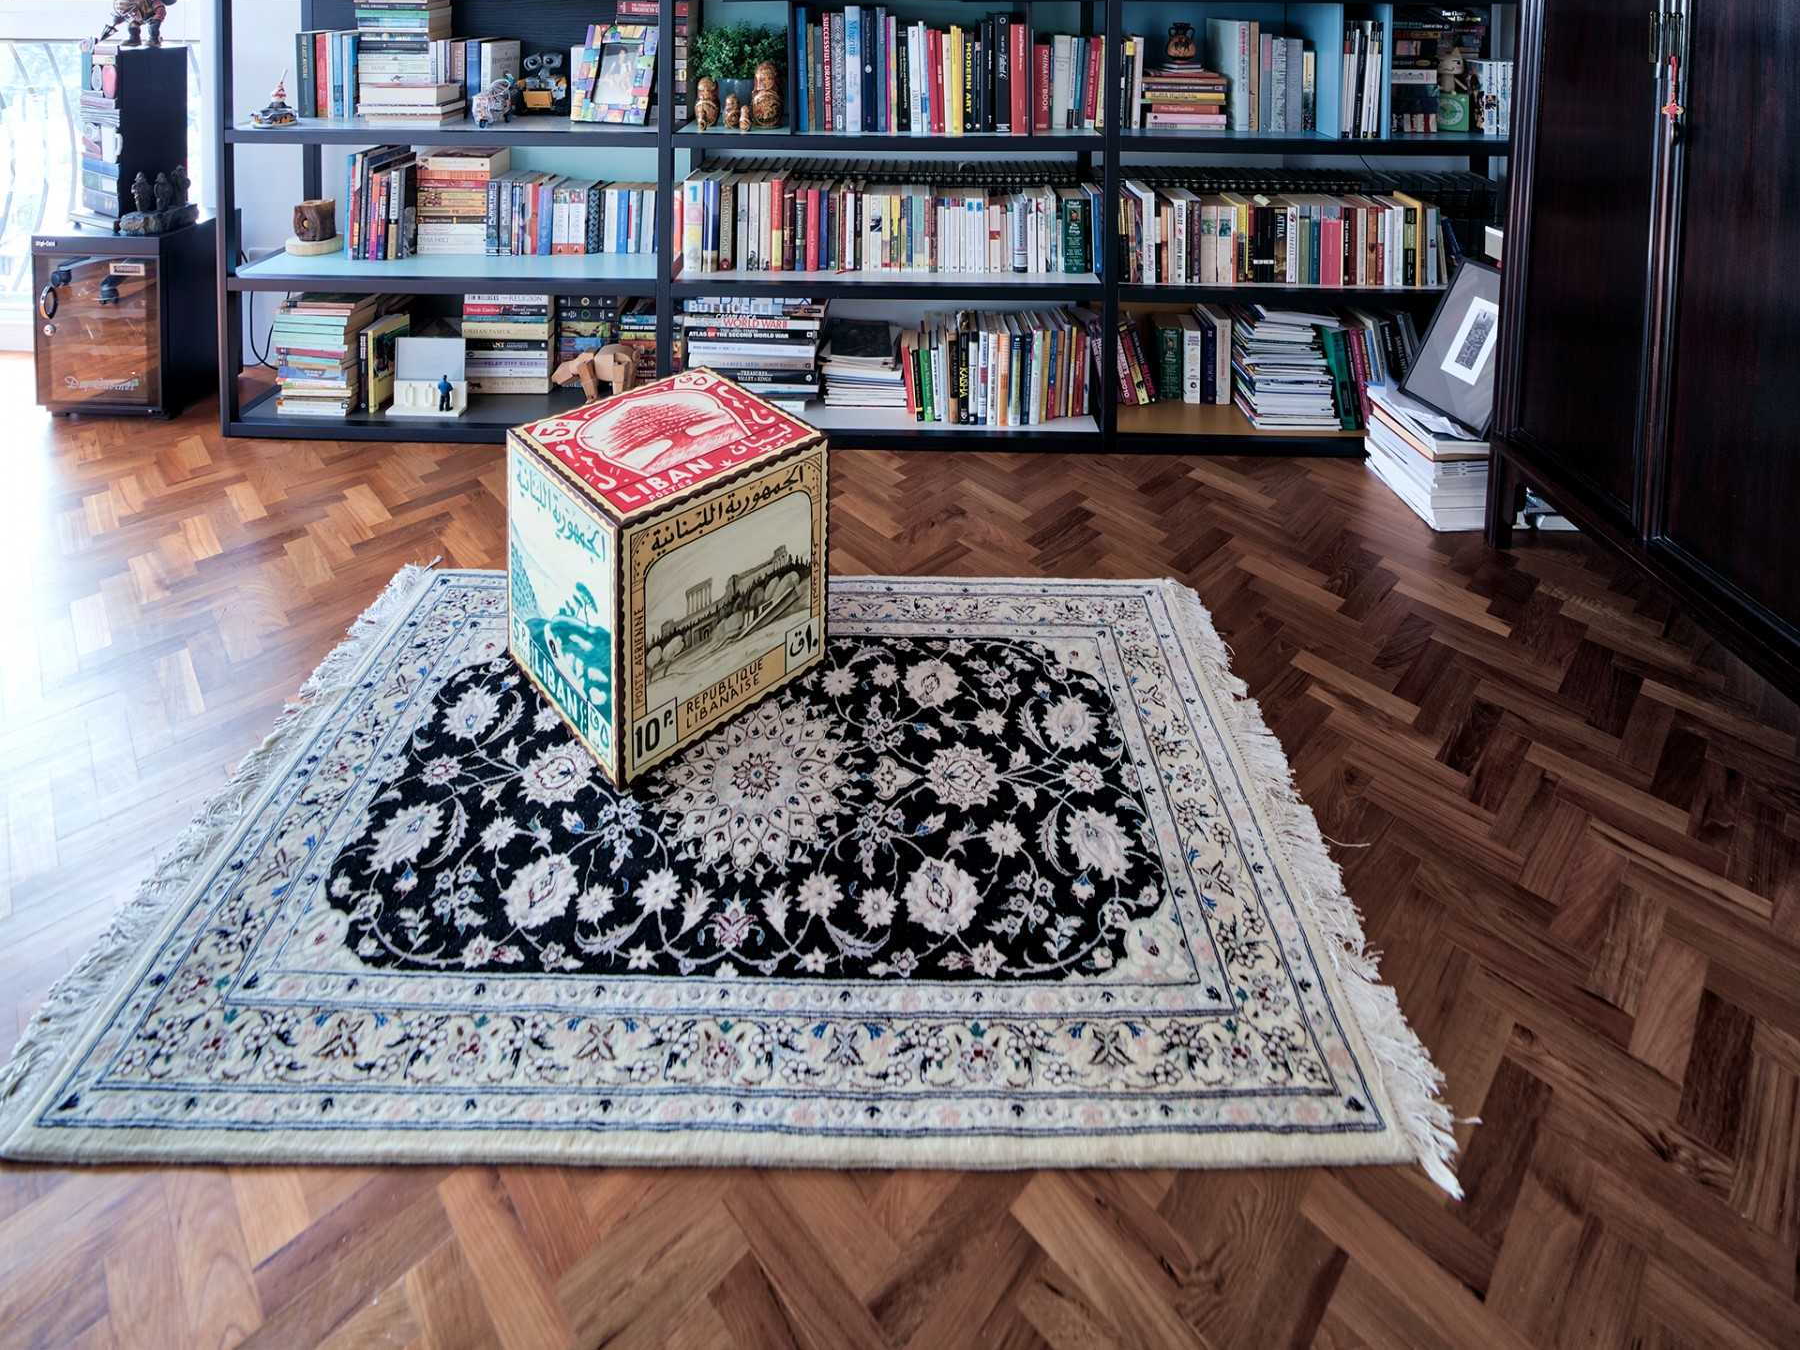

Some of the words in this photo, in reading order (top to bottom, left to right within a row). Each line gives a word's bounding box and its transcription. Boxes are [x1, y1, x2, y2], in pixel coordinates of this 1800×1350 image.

[964, 43, 972, 90] MODERN
[964, 92, 972, 114] ART
[689, 185, 699, 202] 1
[1277, 214, 1285, 238] ATTILA
[723, 319, 760, 328] WORLD
[959, 367, 968, 398] KAISHA
[538, 423, 570, 441] 5
[616, 457, 714, 503] LIBAN
[649, 479, 693, 502] POSTES
[512, 615, 521, 640] 5
[635, 606, 645, 669] AERIENNE
[533, 642, 580, 725] LIBAN
[634, 670, 644, 704] POSTE
[685, 656, 765, 715] REPUBLIQUE
[685, 671, 761, 730] LIBANAISE
[634, 715, 660, 760] 10
